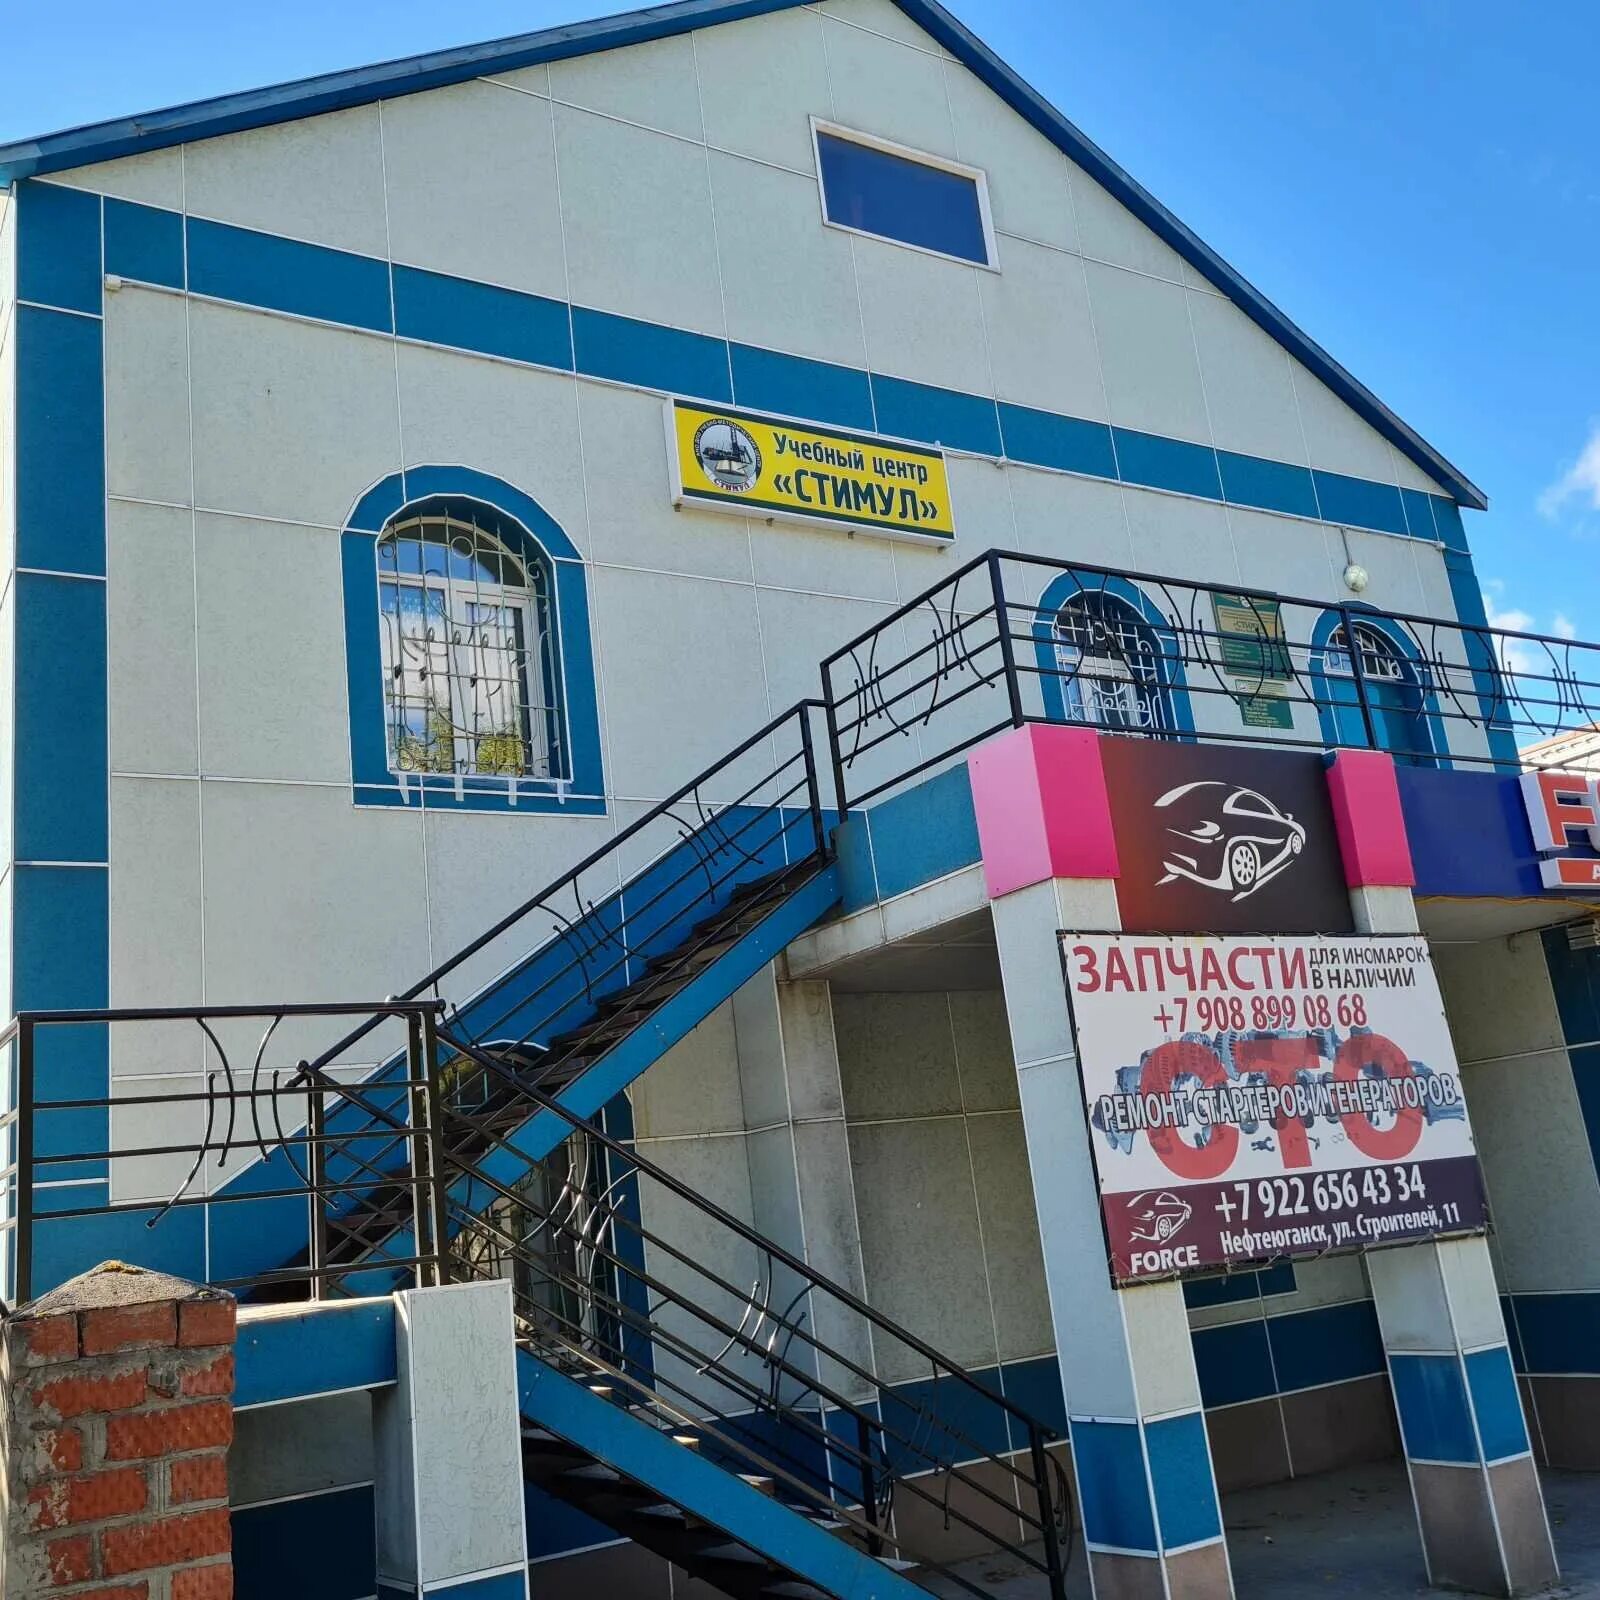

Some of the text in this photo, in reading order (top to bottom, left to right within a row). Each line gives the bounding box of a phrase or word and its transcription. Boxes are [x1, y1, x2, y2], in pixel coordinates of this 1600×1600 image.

[773, 432, 928, 485] Учебный центр
[773, 468, 938, 521] «СТИМУЛ»
[1072, 945, 1308, 993] ЗАПЧАСТИ
[1309, 946, 1426, 968] ДЛЯ ИНОМАРОК
[1312, 967, 1416, 990] В НАЛИЧИИ
[1153, 992, 1367, 1032] +7 908 899 08 68
[1100, 1072, 1456, 1132] РЕМОНТ СТАРТЕРОВ И ГЕНЕРАТОРОВ
[1140, 1033, 1424, 1181] СТО
[1215, 1163, 1426, 1223] +7 922 656 43 34
[1219, 1202, 1462, 1257] Нефтеюганск, ул. Строителей, 11
[1130, 1245, 1201, 1275] FORCE
